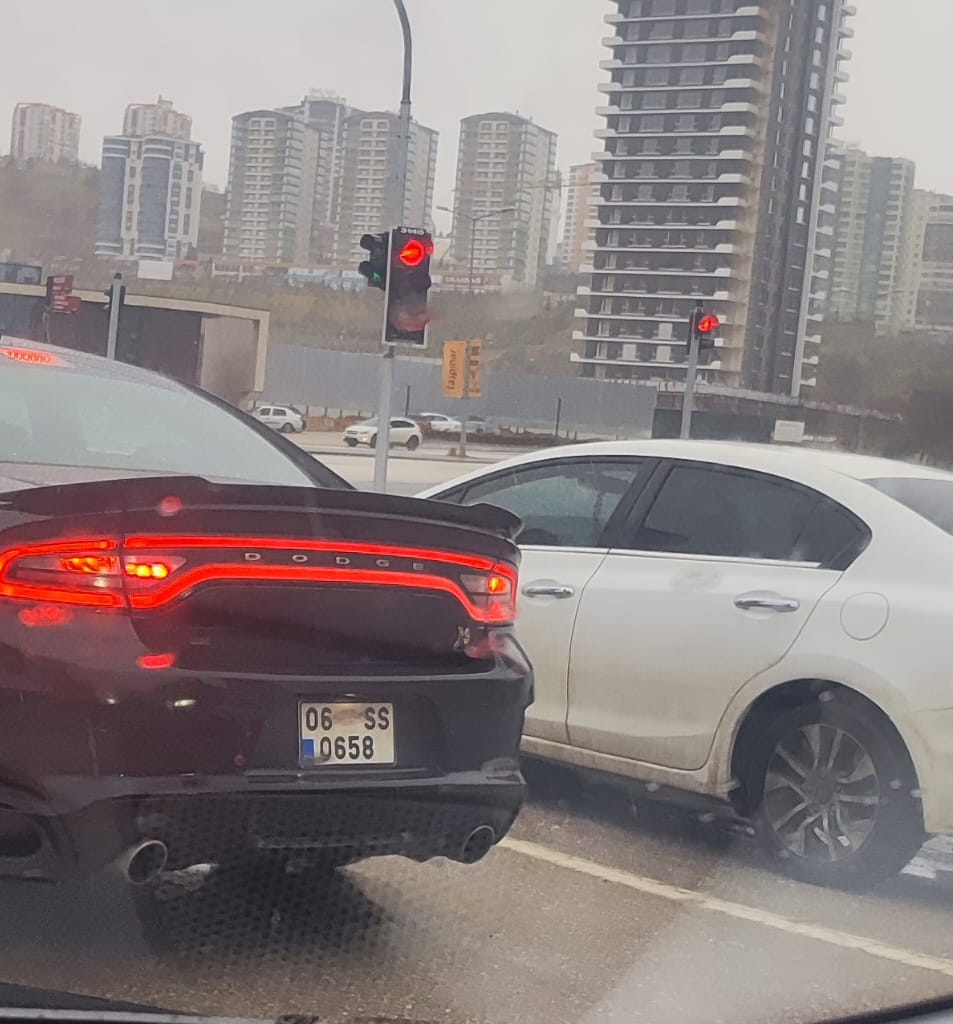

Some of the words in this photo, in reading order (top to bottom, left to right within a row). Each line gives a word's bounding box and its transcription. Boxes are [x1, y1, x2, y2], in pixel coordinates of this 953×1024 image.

[244, 552, 424, 571] DODGE
[306, 706, 333, 731] 06
[364, 706, 390, 730] SS
[319, 735, 374, 761] 0658
